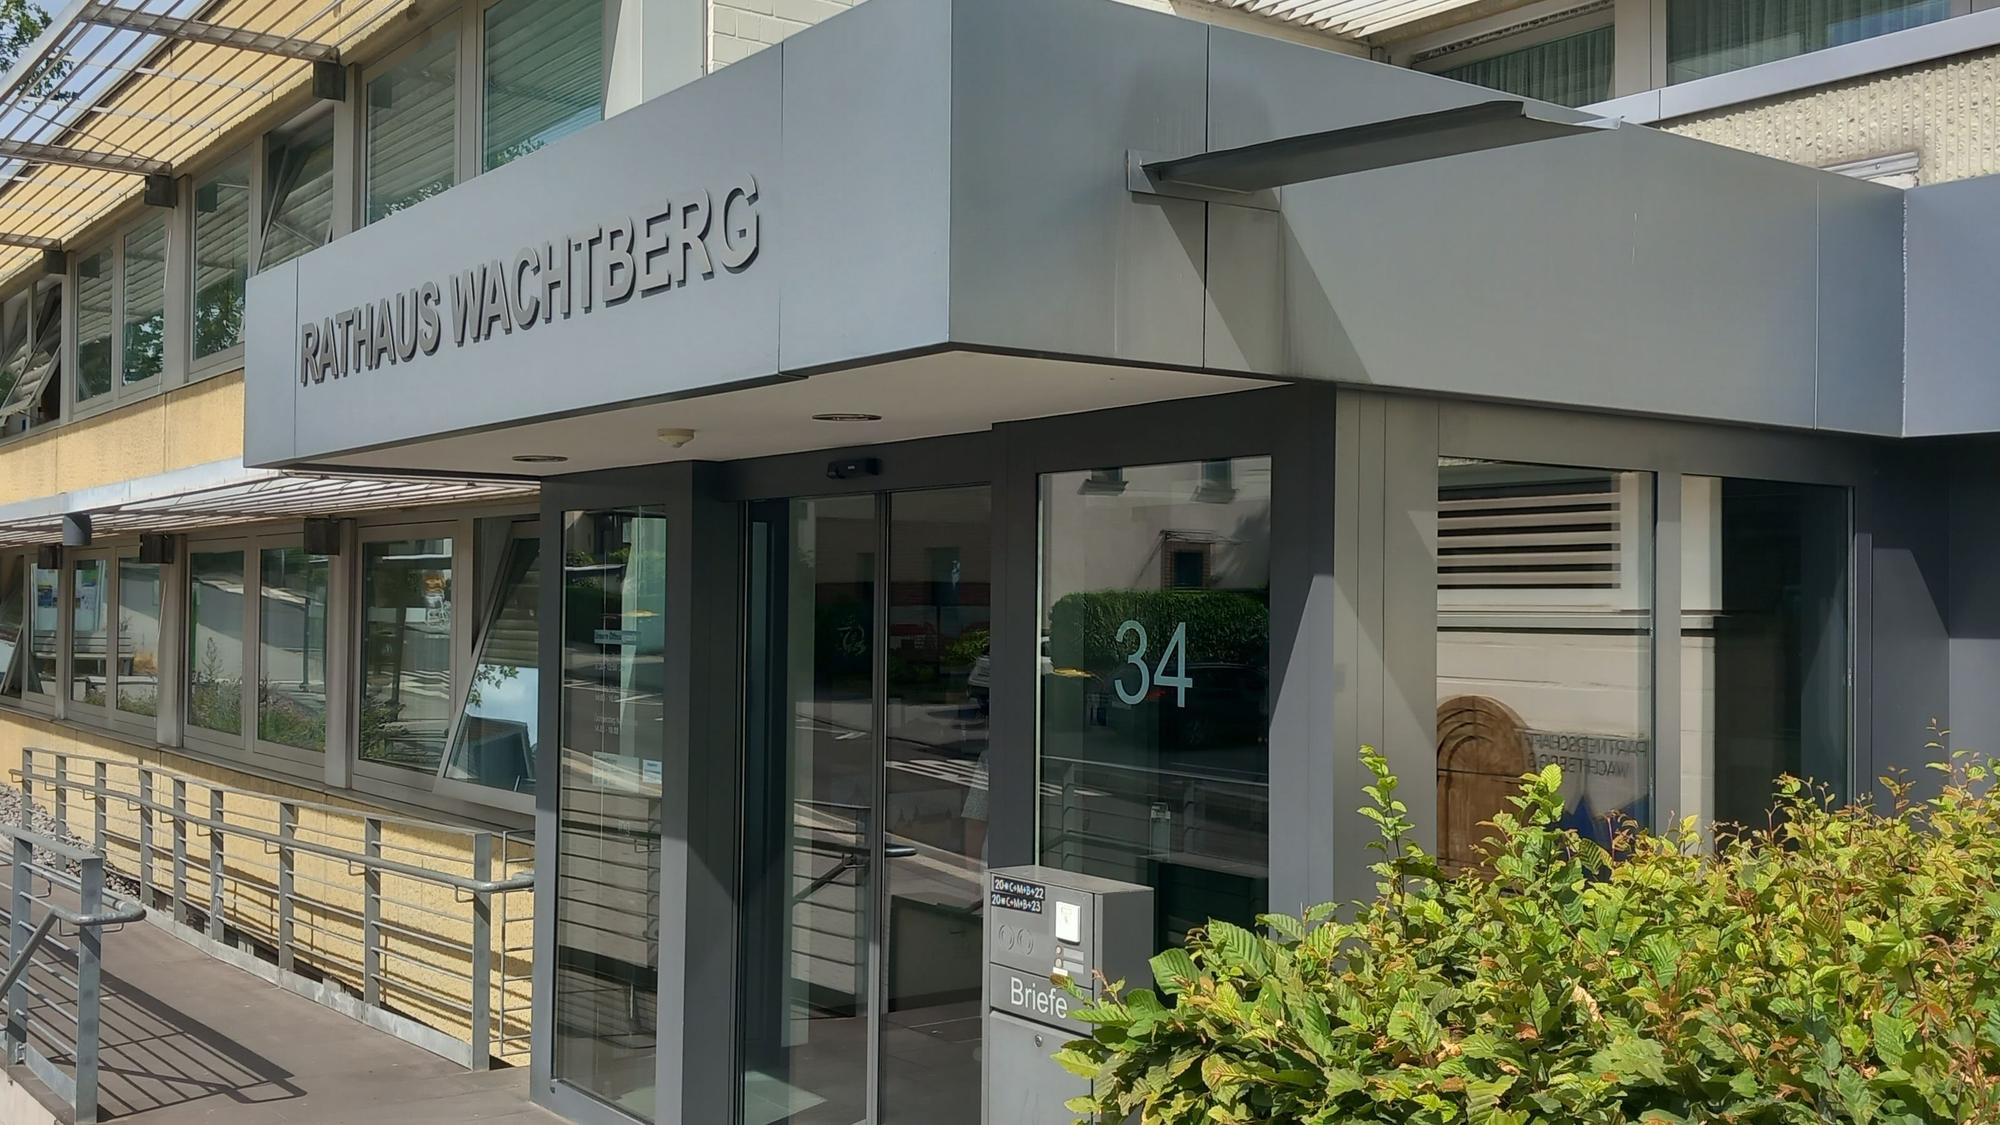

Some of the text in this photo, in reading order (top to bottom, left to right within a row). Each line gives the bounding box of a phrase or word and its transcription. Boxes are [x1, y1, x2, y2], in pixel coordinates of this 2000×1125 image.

[300, 172, 761, 386] RATHAUS WACHTBERG
[1114, 620, 1193, 708] 34
[1010, 976, 1068, 1019] Briefe
